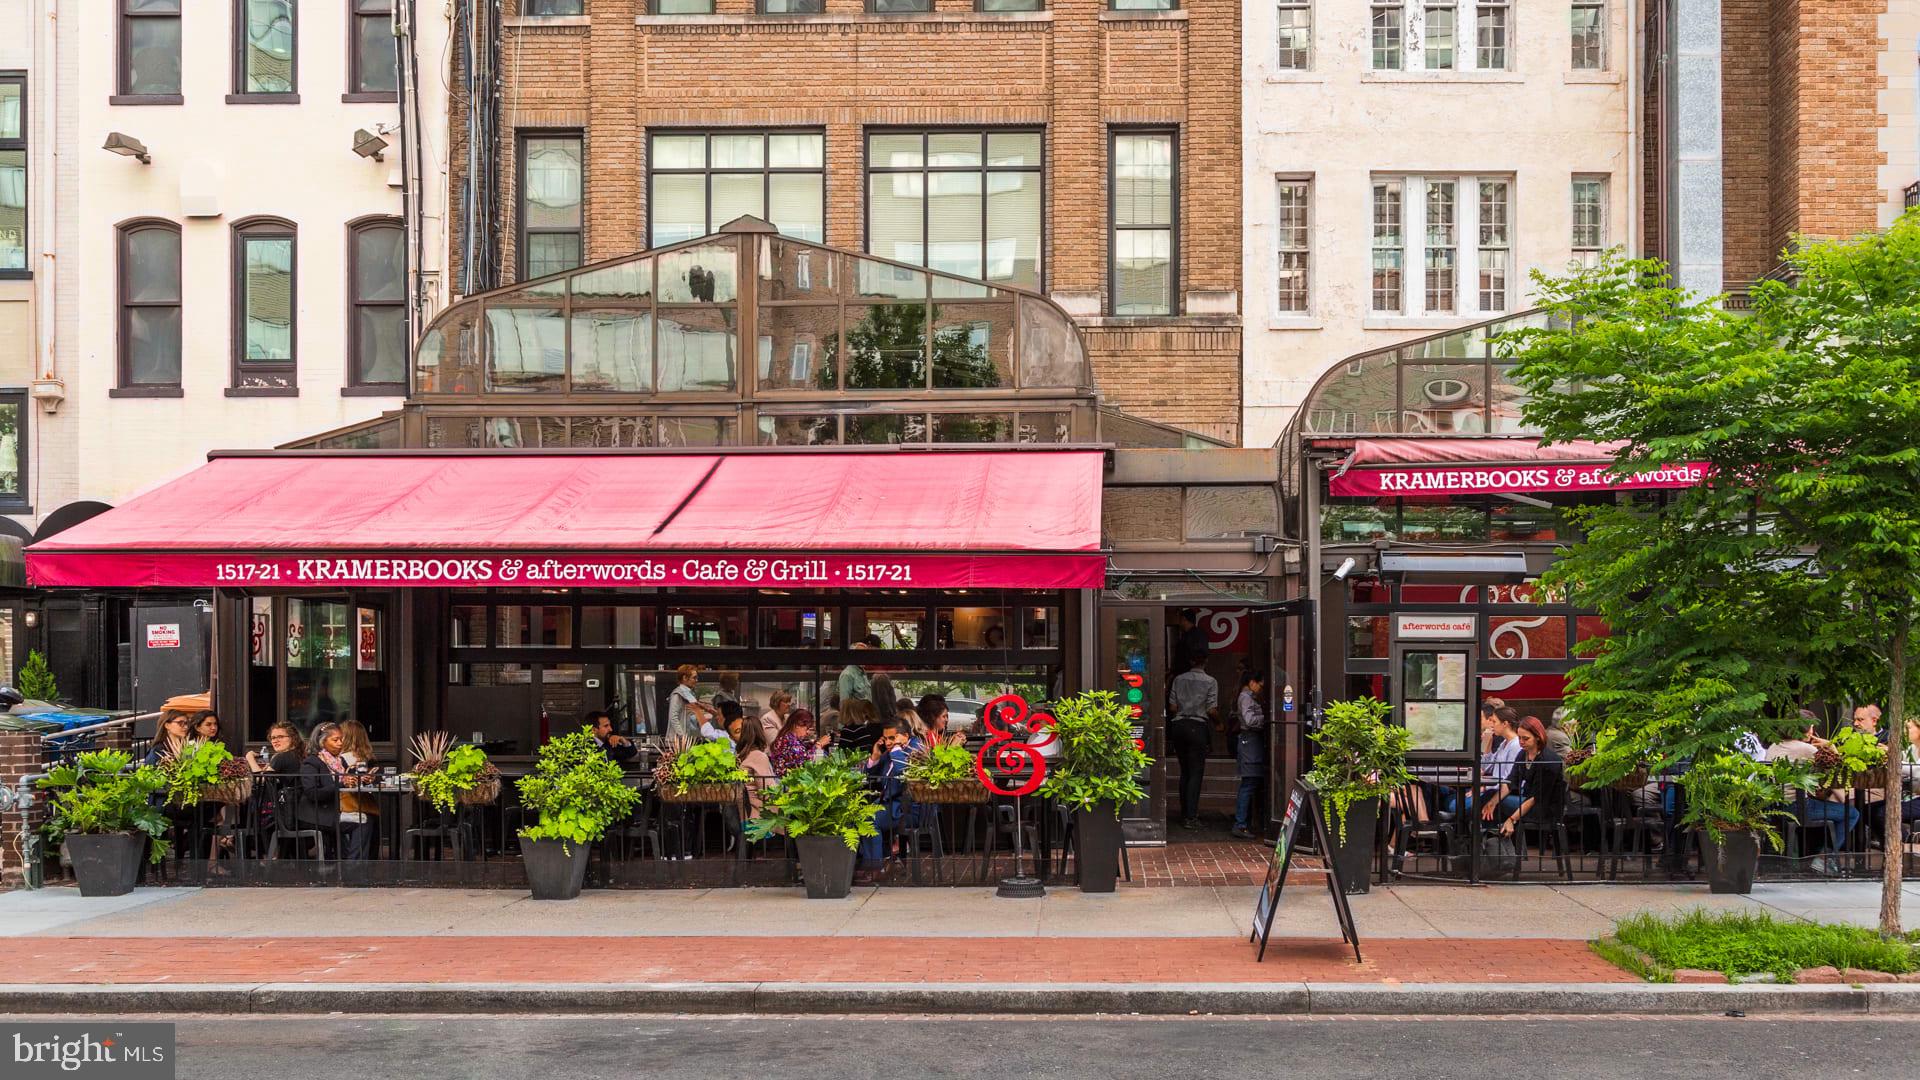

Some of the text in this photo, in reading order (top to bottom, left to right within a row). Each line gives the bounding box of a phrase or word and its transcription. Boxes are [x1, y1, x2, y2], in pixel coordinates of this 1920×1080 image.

[1379, 468, 1550, 490] KRAMERBOOKS
[1554, 468, 1576, 487] &
[216, 558, 912, 582] 1517-21 KRAMERBOOKS & afterwords Cafe & Grill 1517-21
[1402, 622, 1471, 631] afterwords café
